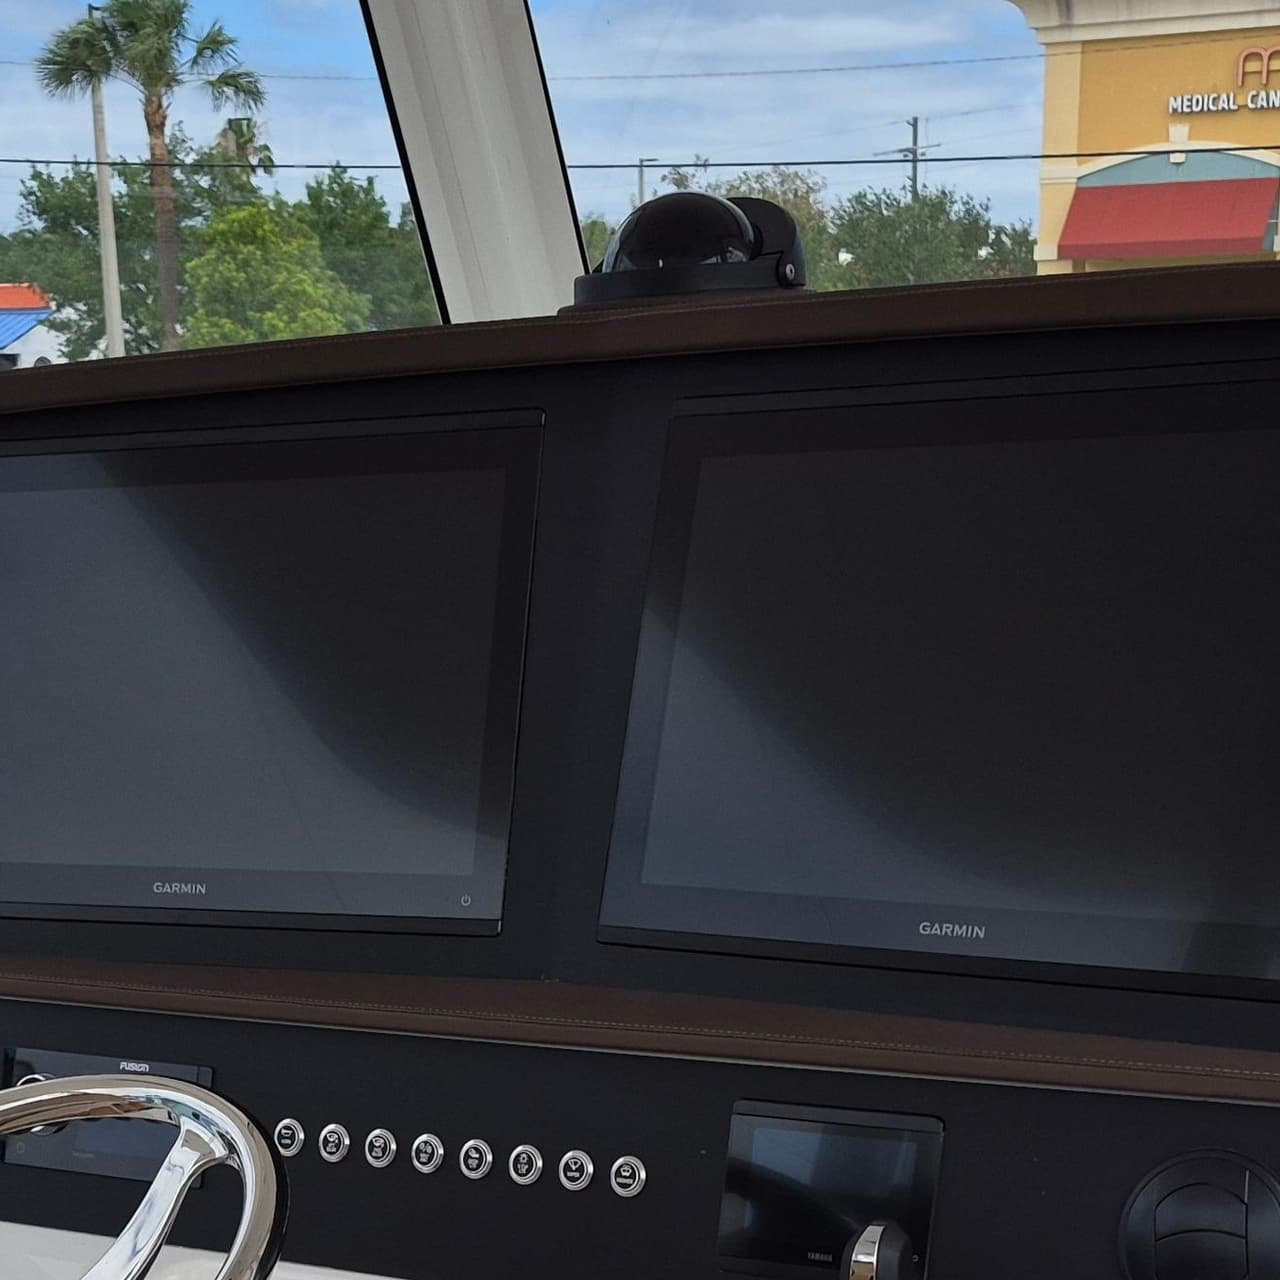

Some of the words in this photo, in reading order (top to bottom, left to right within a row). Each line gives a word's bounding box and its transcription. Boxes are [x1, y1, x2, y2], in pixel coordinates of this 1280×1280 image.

[1169, 91, 1239, 115] MEDICAL
[153, 881, 207, 895] GARMIN
[919, 921, 986, 939] GARMIN
